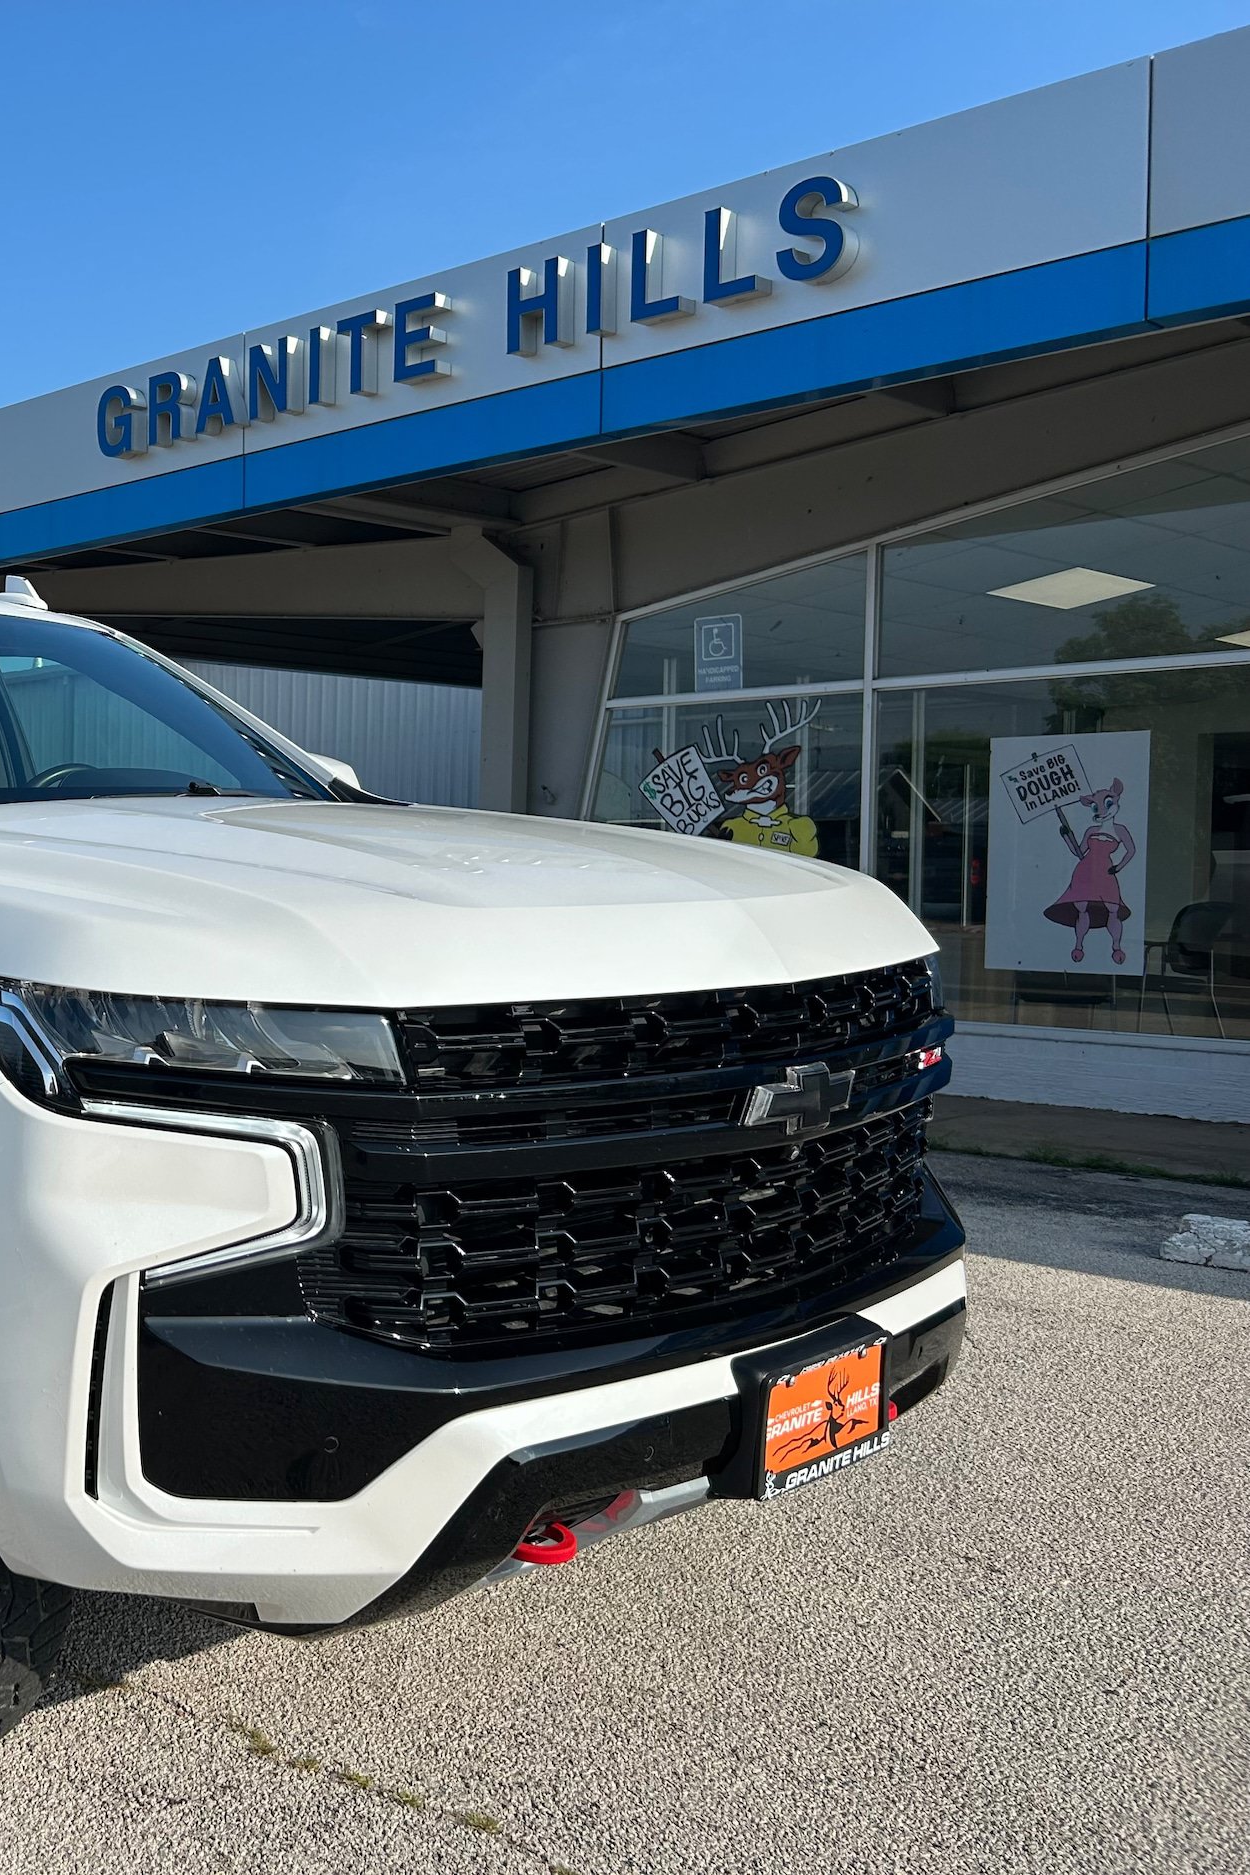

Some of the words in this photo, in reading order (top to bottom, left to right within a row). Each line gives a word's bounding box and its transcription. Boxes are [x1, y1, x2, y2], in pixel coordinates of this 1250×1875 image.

[97, 291, 452, 460] GRANITE
[505, 175, 860, 357] HILLS
[652, 751, 698, 793] SAVE
[1015, 764, 1075, 802] DOUGH
[1019, 765, 1046, 781] Save
[1046, 754, 1066, 770] BIG
[660, 774, 706, 818] BIG
[676, 791, 721, 834] BUCKS
[1037, 779, 1081, 806] LLANO!
[775, 1401, 811, 1420] CHEVROLET
[846, 1382, 880, 1409] HILLS
[785, 1448, 852, 1490] GRANITE
[852, 1431, 890, 1463] HILLS
